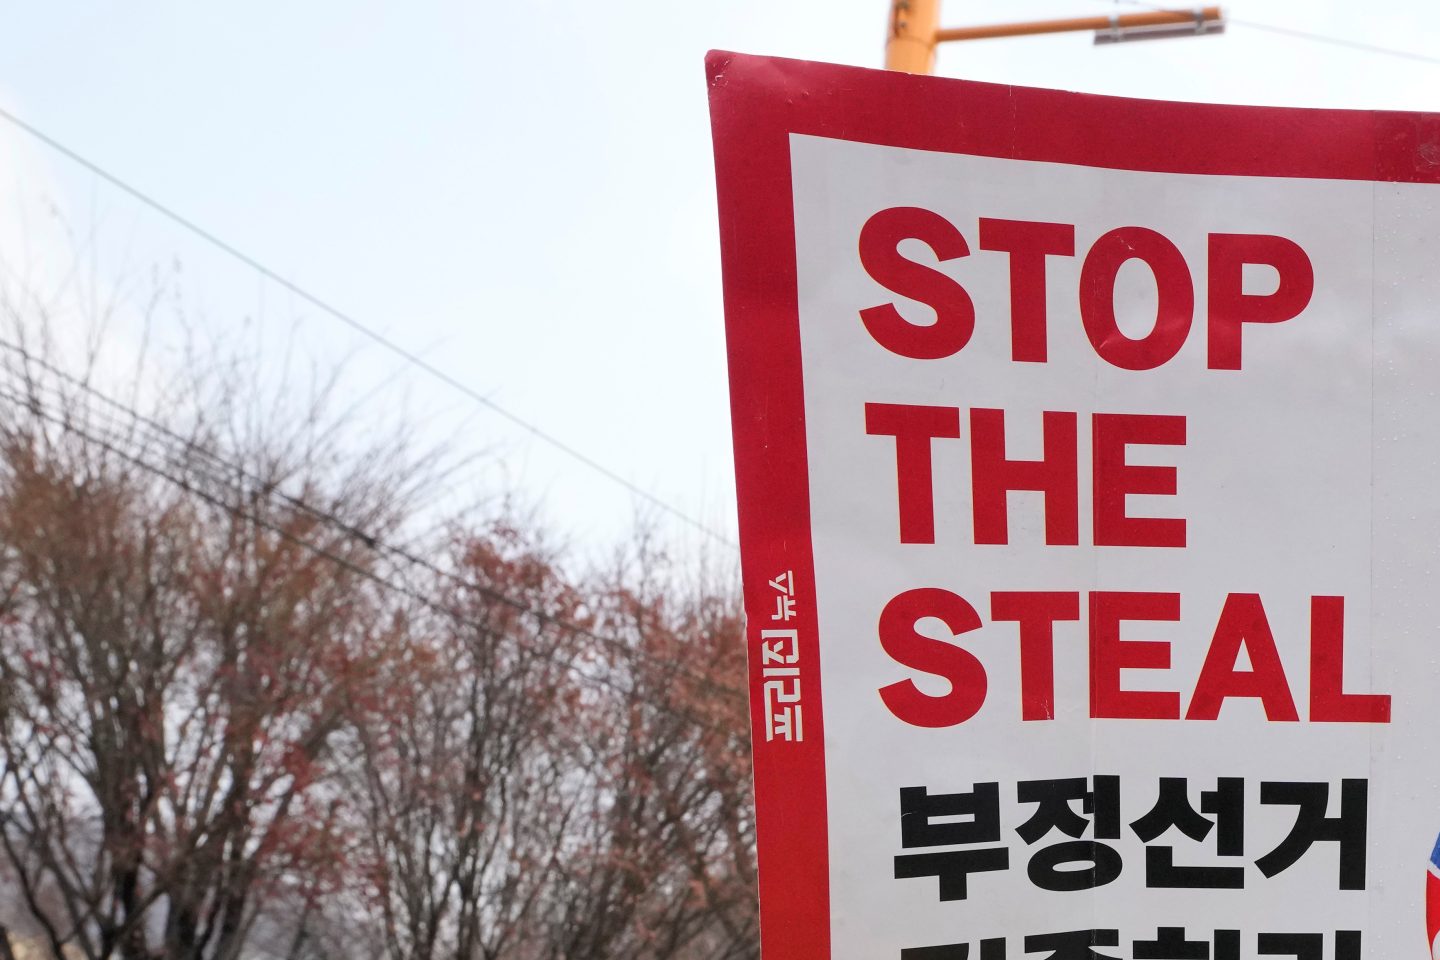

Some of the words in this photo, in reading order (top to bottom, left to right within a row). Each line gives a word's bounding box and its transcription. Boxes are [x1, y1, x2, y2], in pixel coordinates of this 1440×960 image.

[858, 206, 1314, 370] STOP
[864, 402, 1187, 548] THE
[769, 570, 797, 621] 뉴스
[878, 587, 1391, 728] STEAL
[761, 629, 804, 742] 프리진
[894, 775, 1368, 902] 부정선거
